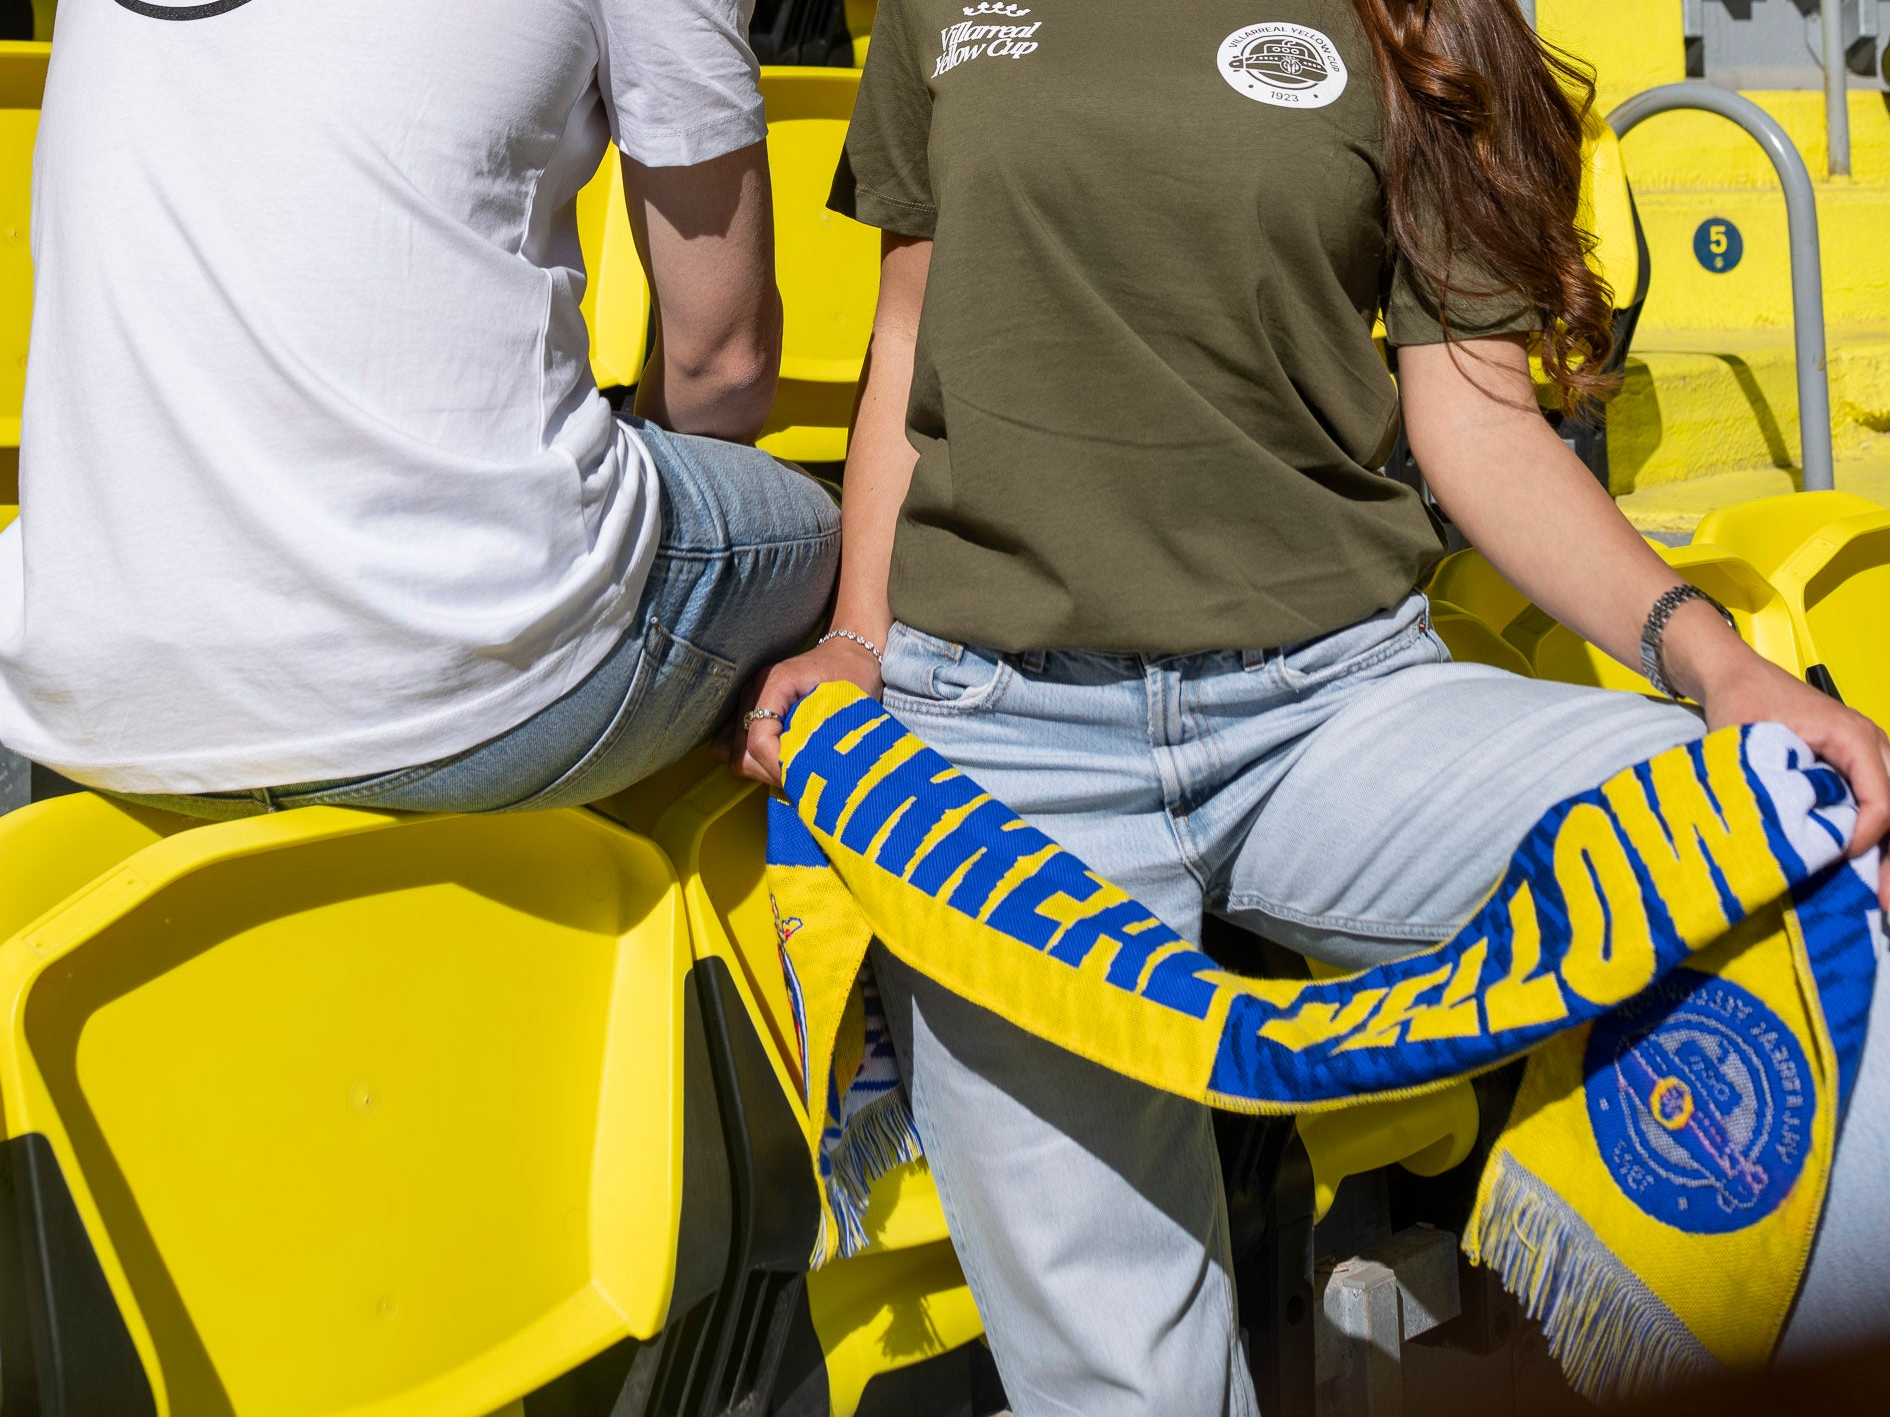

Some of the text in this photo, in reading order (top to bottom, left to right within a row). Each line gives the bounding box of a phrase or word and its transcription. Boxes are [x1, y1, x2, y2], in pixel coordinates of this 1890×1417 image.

[940, 20, 1043, 52] Villarreal
[1228, 26, 1340, 73] VILLARREAL YELLOW CUP
[930, 38, 1039, 79] Yellow Cup
[1270, 91, 1300, 103] 1923
[1709, 225, 1728, 255] 5
[782, 696, 1222, 1020] ARREAL
